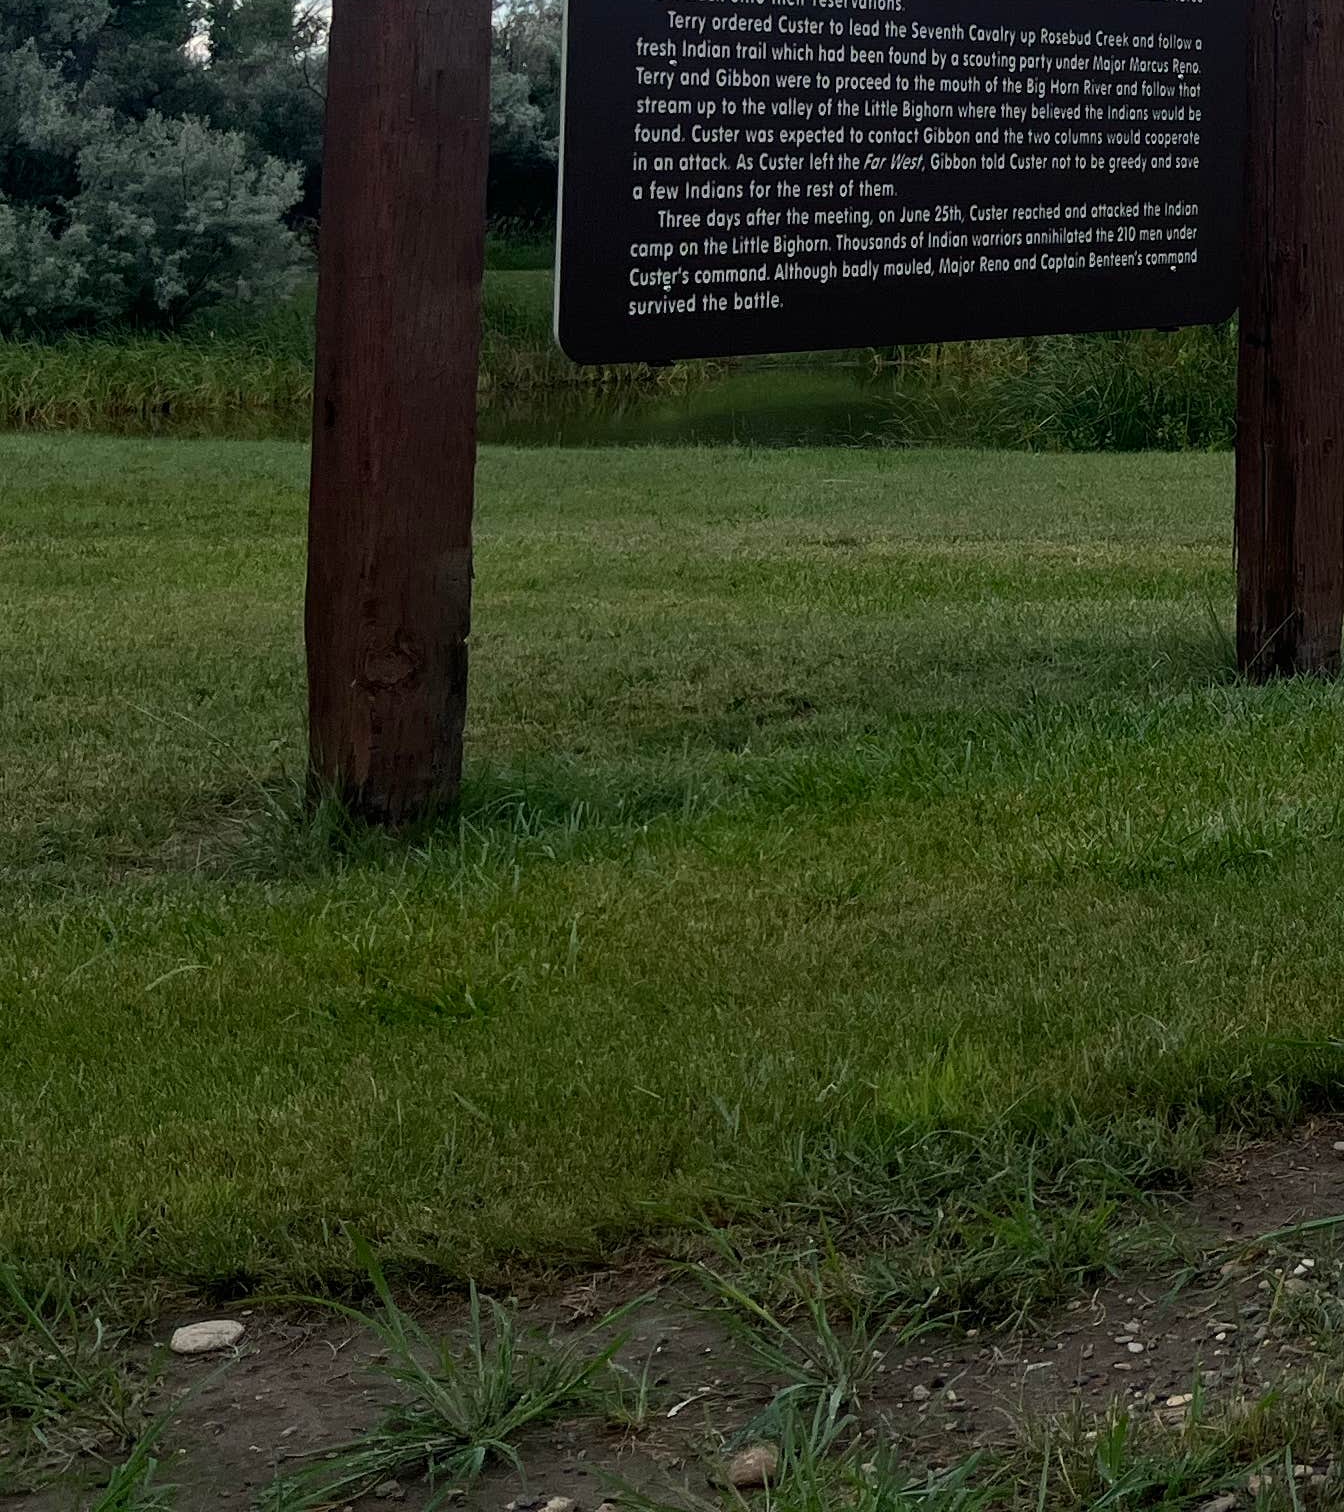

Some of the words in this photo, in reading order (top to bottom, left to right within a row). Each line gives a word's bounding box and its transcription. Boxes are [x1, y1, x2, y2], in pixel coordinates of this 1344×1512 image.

[667, 10, 707, 35] Terry
[711, 12, 773, 33] ordered
[777, 15, 825, 35] Custer
[849, 17, 880, 37] lead
[911, 21, 965, 41] Seventh
[968, 23, 1016, 47] Cavalry
[1040, 27, 1092, 46] Rosebud
[1095, 30, 1130, 48] Creek
[1132, 32, 1155, 49] and
[1157, 32, 1193, 50] follow
[636, 36, 677, 57] fresh
[681, 39, 731, 59] Indian
[735, 41, 767, 60] trail
[771, 41, 814, 62] which
[818, 43, 845, 63] had
[849, 44, 885, 64] been
[887, 45, 927, 65] found
[962, 50, 1017, 73] scouting
[1019, 53, 1053, 73] party
[1055, 53, 1090, 71] under
[1092, 54, 1127, 75] Major
[1129, 56, 1169, 73] Marcus
[1172, 57, 1201, 75] Reno.
[635, 66, 675, 91] Terry
[679, 67, 710, 87] and
[715, 67, 771, 88] Gibbon
[775, 74, 812, 89] were
[835, 72, 892, 94] proceed
[939, 75, 981, 93] mouth
[1050, 78, 1080, 95] Horn
[1083, 78, 1113, 96] River
[1115, 80, 1138, 96] and
[1141, 79, 1176, 97] follow
[1178, 81, 1201, 98] that
[636, 95, 692, 115] stream
[771, 97, 814, 121] valley
[864, 98, 899, 118] Little
[902, 99, 954, 122] Bighorn
[957, 101, 997, 119] where
[1000, 102, 1027, 123] they
[1031, 102, 1081, 120] believed
[1107, 103, 1149, 121] Indians
[1151, 105, 1185, 121] would
[634, 122, 686, 143] found.
[691, 124, 741, 143] Custer
[745, 128, 775, 143] was
[779, 125, 845, 148] expected
[867, 127, 920, 144] contact
[923, 125, 971, 145] Gibbon
[974, 127, 1000, 144] and
[1027, 128, 1051, 145] two
[1054, 127, 1103, 145] columns
[1106, 128, 1141, 145] would
[1144, 130, 1200, 149] cooperate
[678, 152, 731, 171] attack.
[759, 152, 805, 171] Custer
[890, 153, 926, 172] West,
[930, 152, 977, 171] Gibbon
[980, 152, 1006, 170] told
[1009, 152, 1048, 170] Custer
[1108, 153, 1148, 174] greedy
[1150, 152, 1172, 169] and
[1175, 156, 1200, 169] save
[649, 179, 679, 200] few
[685, 180, 744, 200] Indians
[806, 180, 835, 198] rest
[858, 179, 898, 197] them.
[657, 209, 701, 228] Three
[706, 208, 741, 231] days
[745, 207, 782, 227] after
[814, 206, 874, 229] meeting,
[899, 206, 931, 223] June
[934, 204, 965, 224] 25th,
[969, 204, 1009, 222] Custer
[1012, 202, 1061, 221] reached
[1064, 202, 1087, 219] and
[1090, 201, 1140, 219] attacked
[1164, 199, 1199, 217] Indian
[629, 242, 674, 262] camp
[732, 235, 770, 255] Little
[773, 234, 832, 258] Bighorn.
[835, 232, 907, 251] Thousands
[927, 230, 968, 249] Indian
[971, 228, 1023, 247] warriors
[1025, 226, 1093, 245] annihilated
[1139, 228, 1163, 241] men
[1166, 224, 1198, 241] under
[629, 266, 690, 287] Custer's
[694, 263, 771, 284] command.
[773, 260, 838, 284] Although
[842, 259, 880, 281] badly
[883, 257, 935, 277] mauled,
[938, 255, 976, 278] Major
[979, 255, 1010, 272] Reno
[1013, 253, 1037, 271] and
[1040, 251, 1086, 274] Captain
[1088, 249, 1143, 268] Benteen's
[1145, 247, 1198, 266] command
[628, 293, 696, 316] survived
[733, 290, 784, 310] battle.
